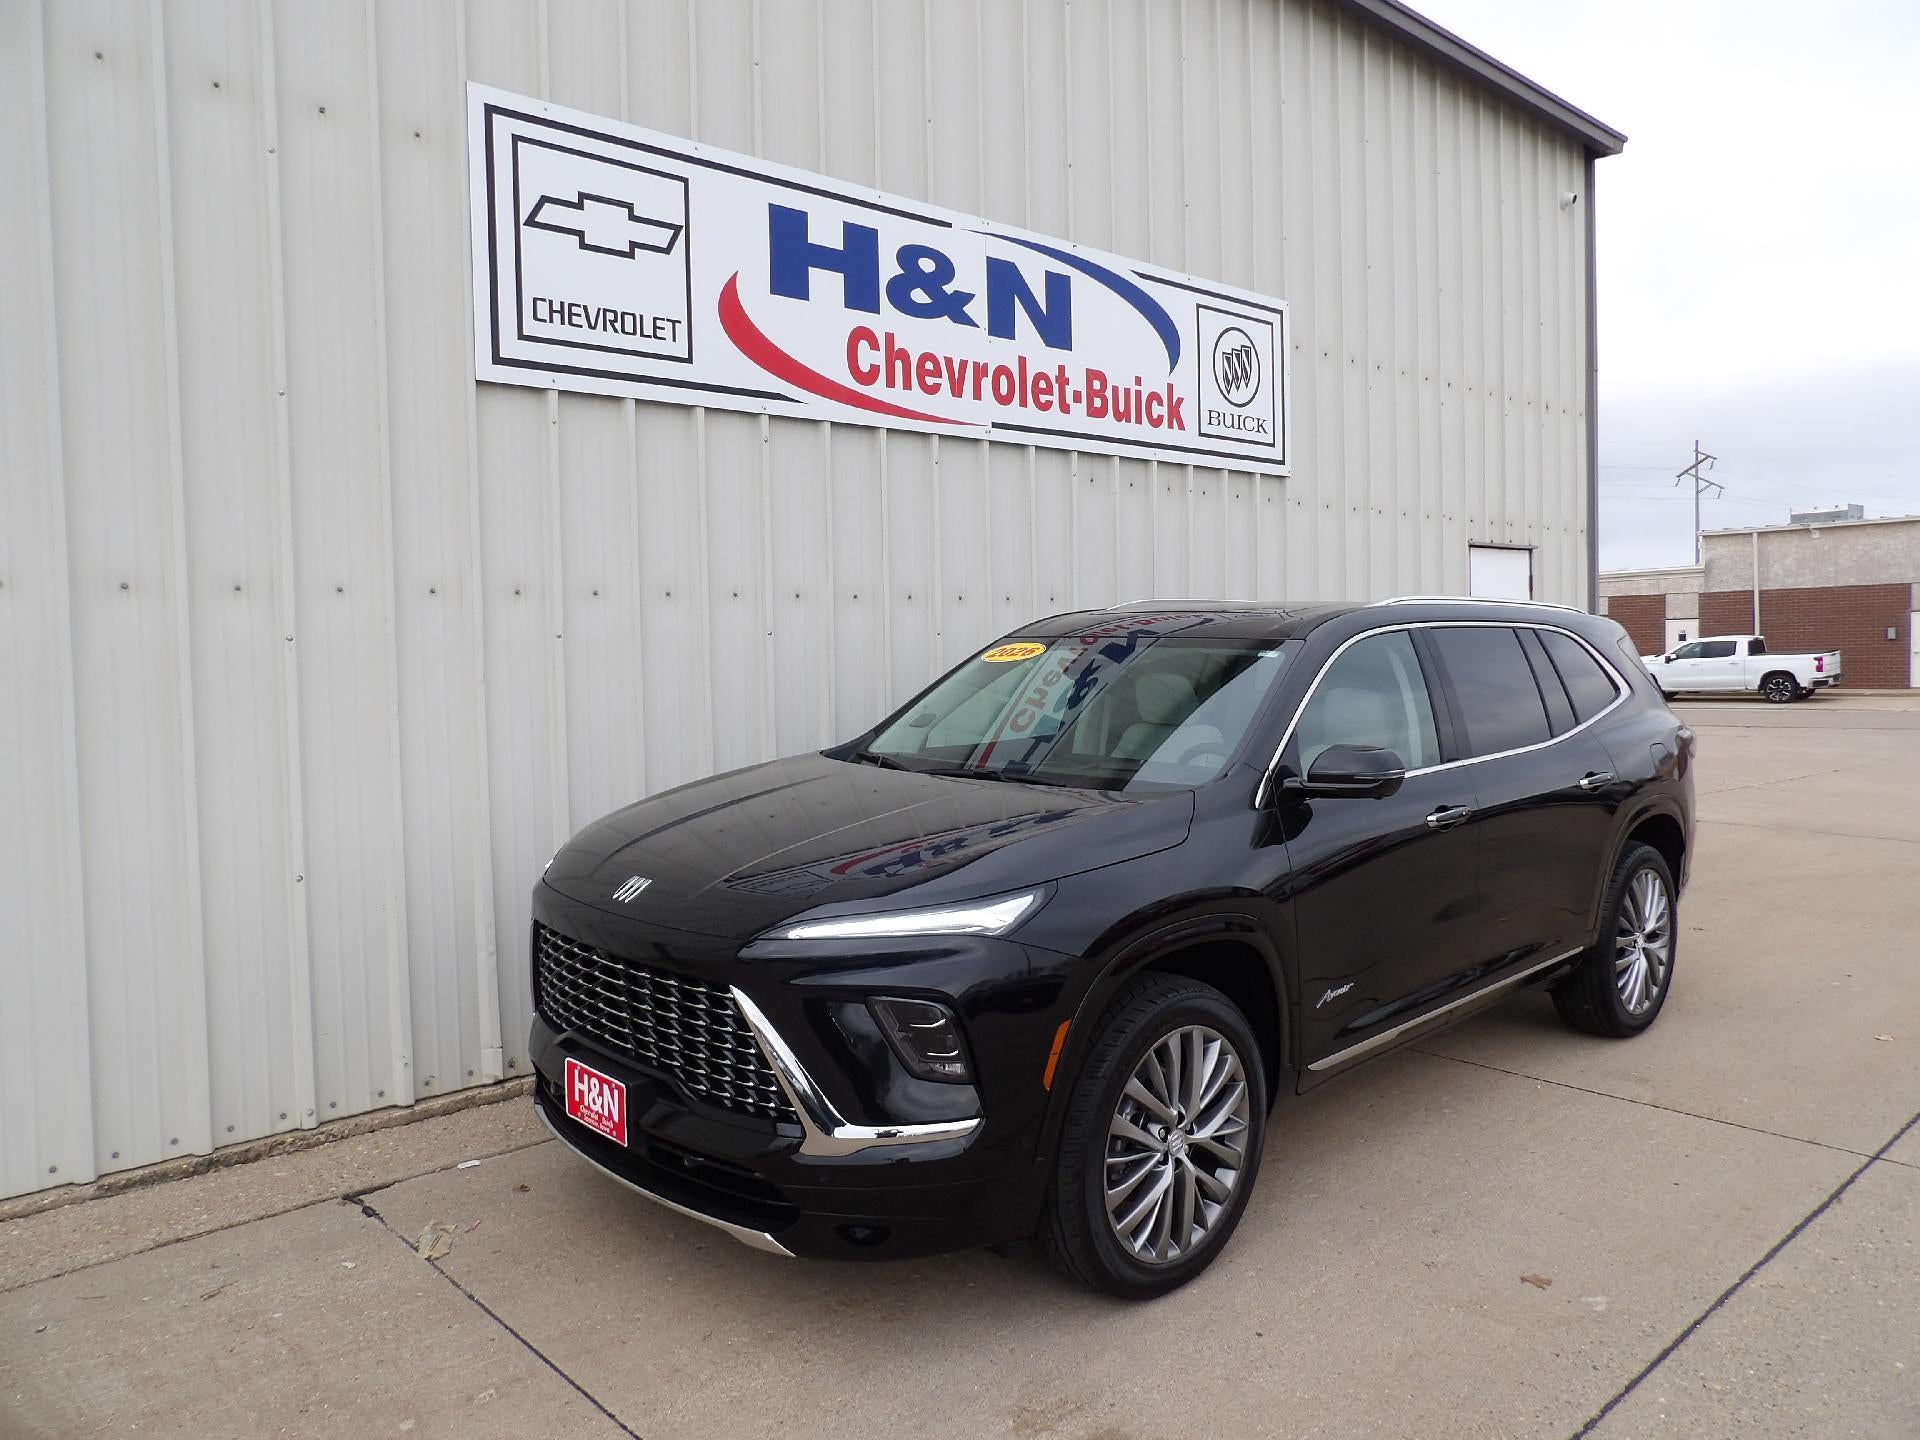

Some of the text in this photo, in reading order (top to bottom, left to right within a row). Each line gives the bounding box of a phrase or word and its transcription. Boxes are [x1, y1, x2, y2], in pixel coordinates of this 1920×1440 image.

[768, 202, 1073, 352] H&N
[532, 296, 682, 343] CHEVROLET
[846, 325, 1186, 431] Chevrolet-Buick
[1207, 408, 1269, 435] BUICK
[574, 1068, 619, 1124] H&N
